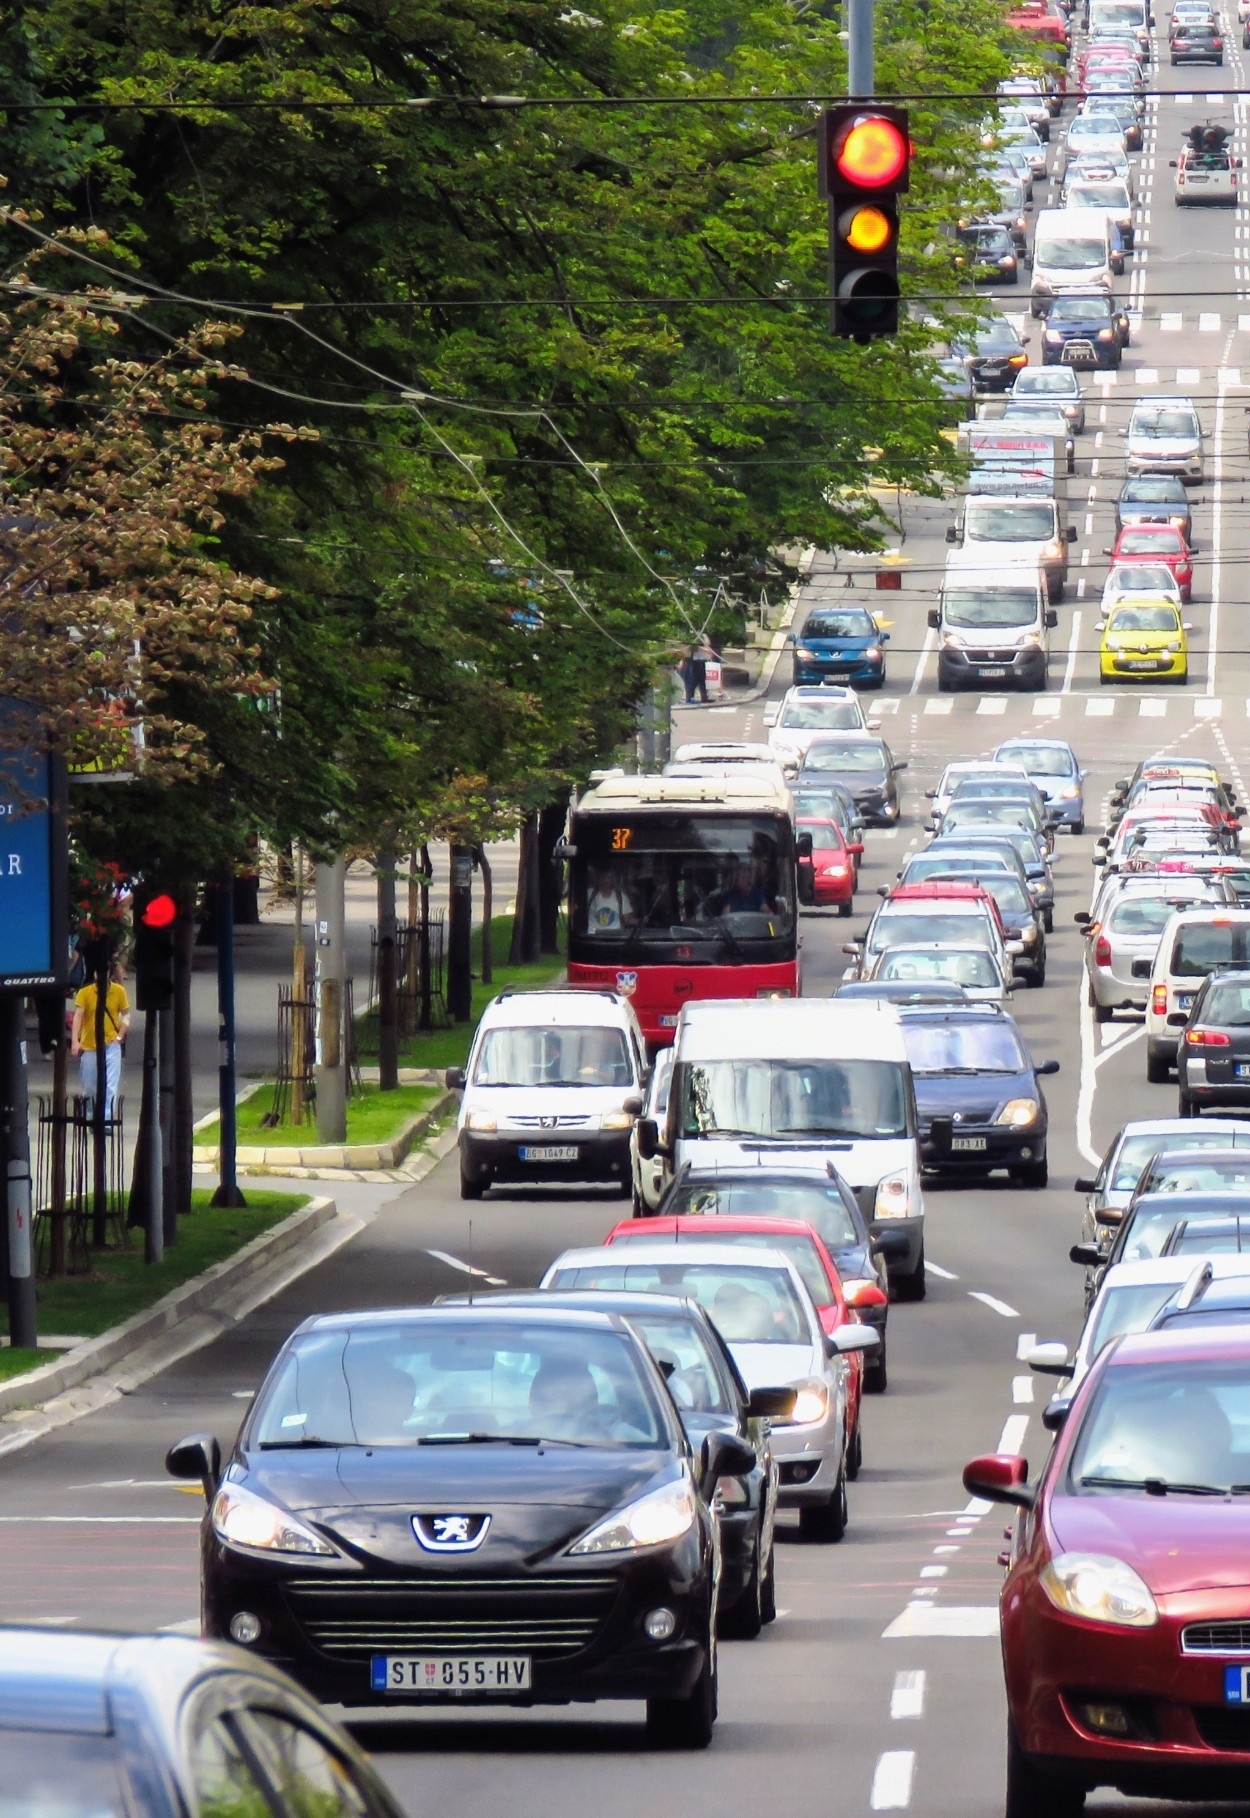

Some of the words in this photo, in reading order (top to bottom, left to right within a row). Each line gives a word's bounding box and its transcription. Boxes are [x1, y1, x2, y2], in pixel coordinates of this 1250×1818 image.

[612, 828, 631, 849] 37
[3, 977, 56, 986] QUATTRO
[392, 1661, 420, 1685] ST
